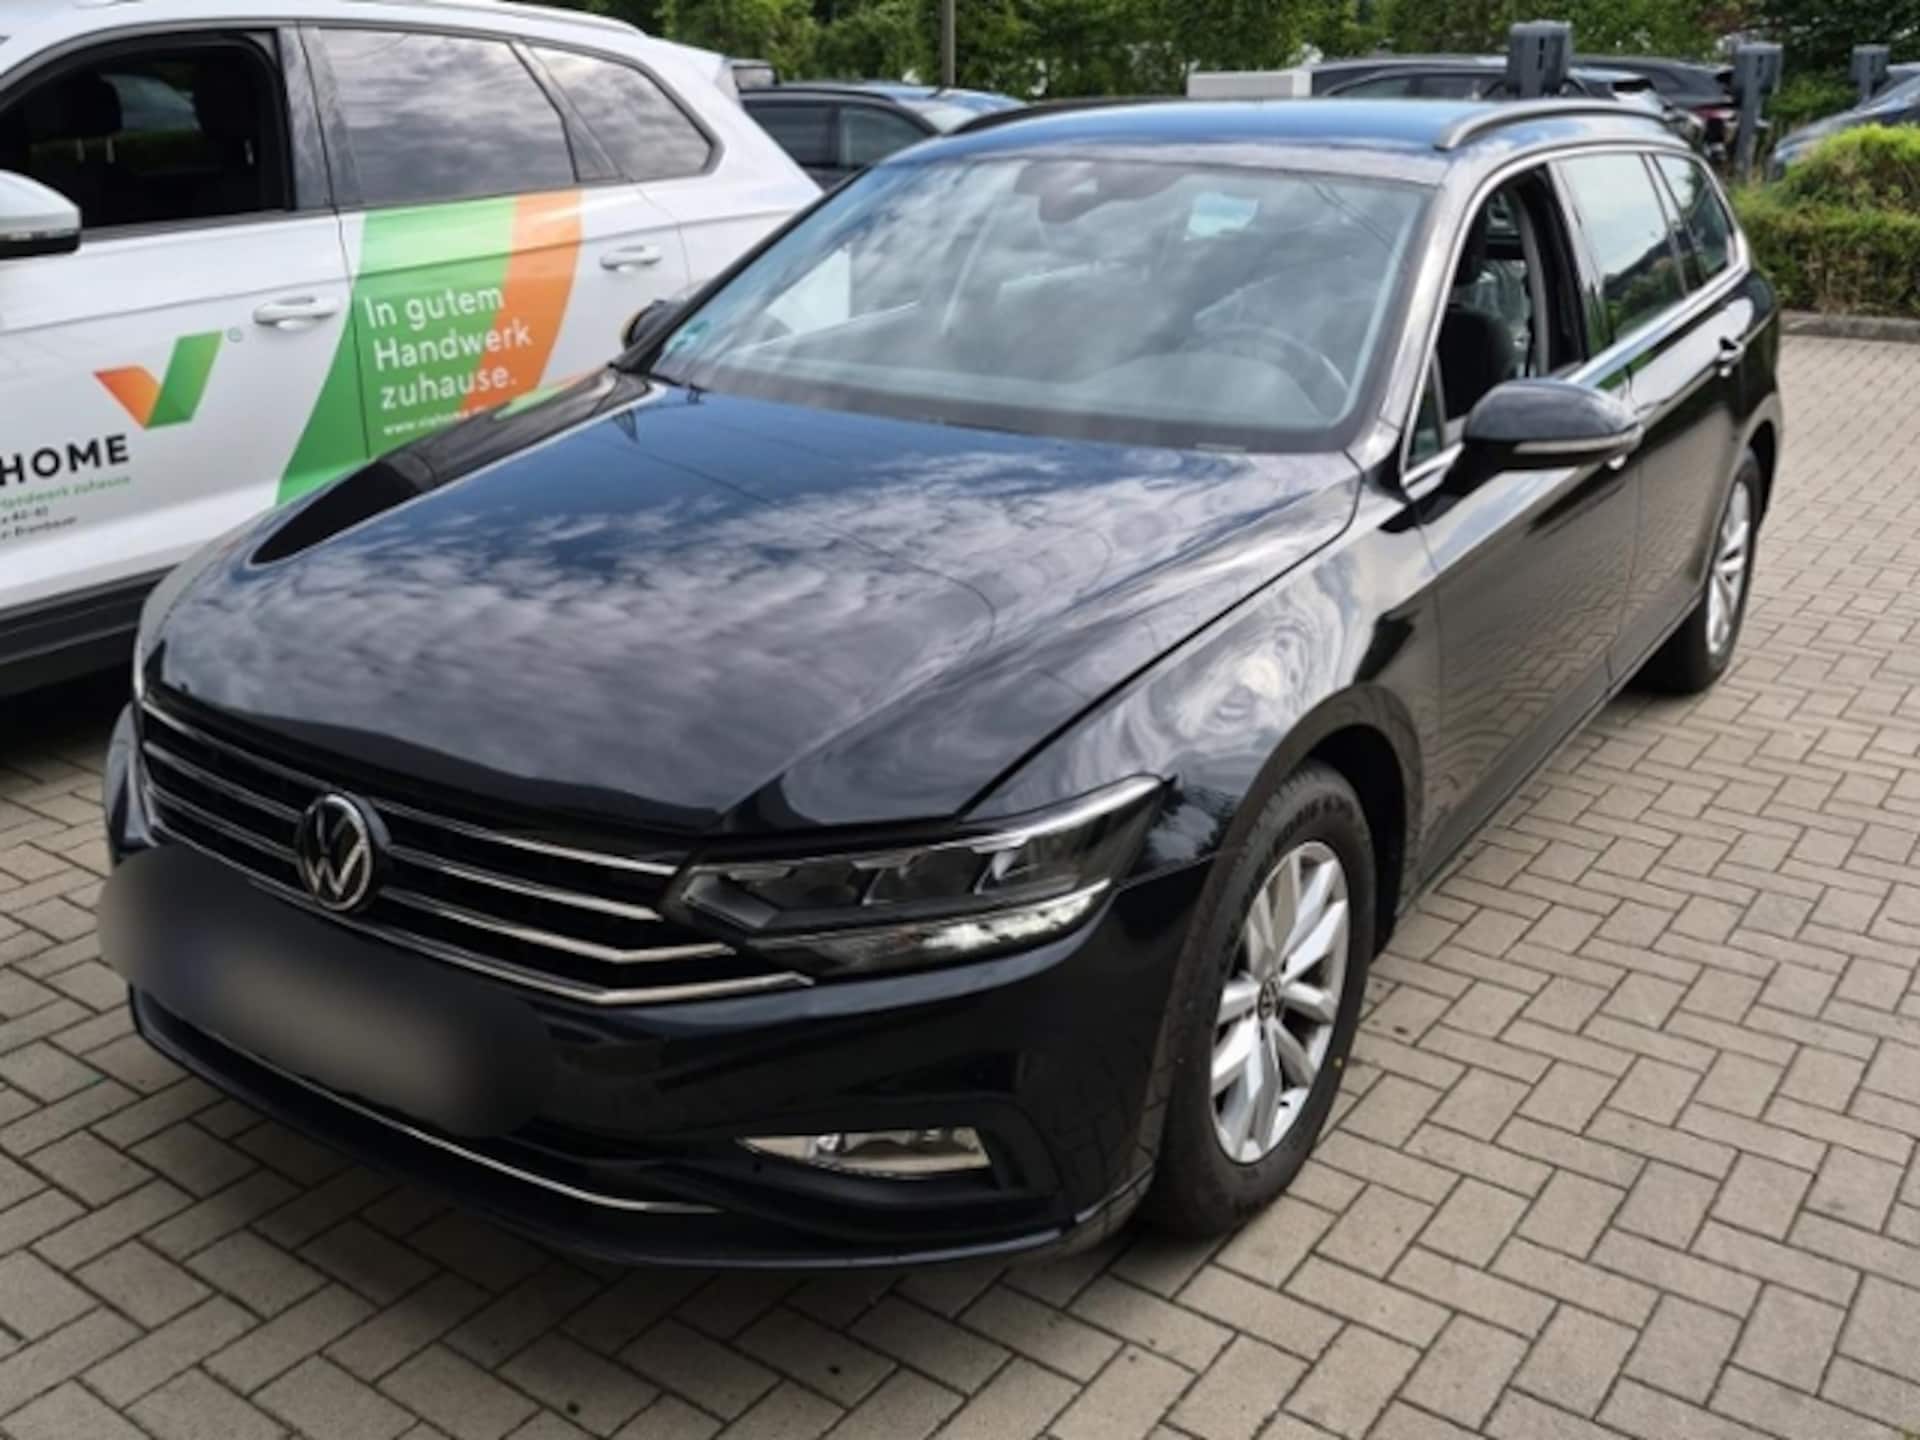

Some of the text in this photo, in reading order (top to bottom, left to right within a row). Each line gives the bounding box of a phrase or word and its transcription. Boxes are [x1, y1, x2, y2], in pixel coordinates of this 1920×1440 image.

[364, 286, 506, 331] In gutem
[373, 317, 532, 371] Handwerk
[380, 366, 517, 410] zuhause.
[0, 433, 129, 486] HOME
